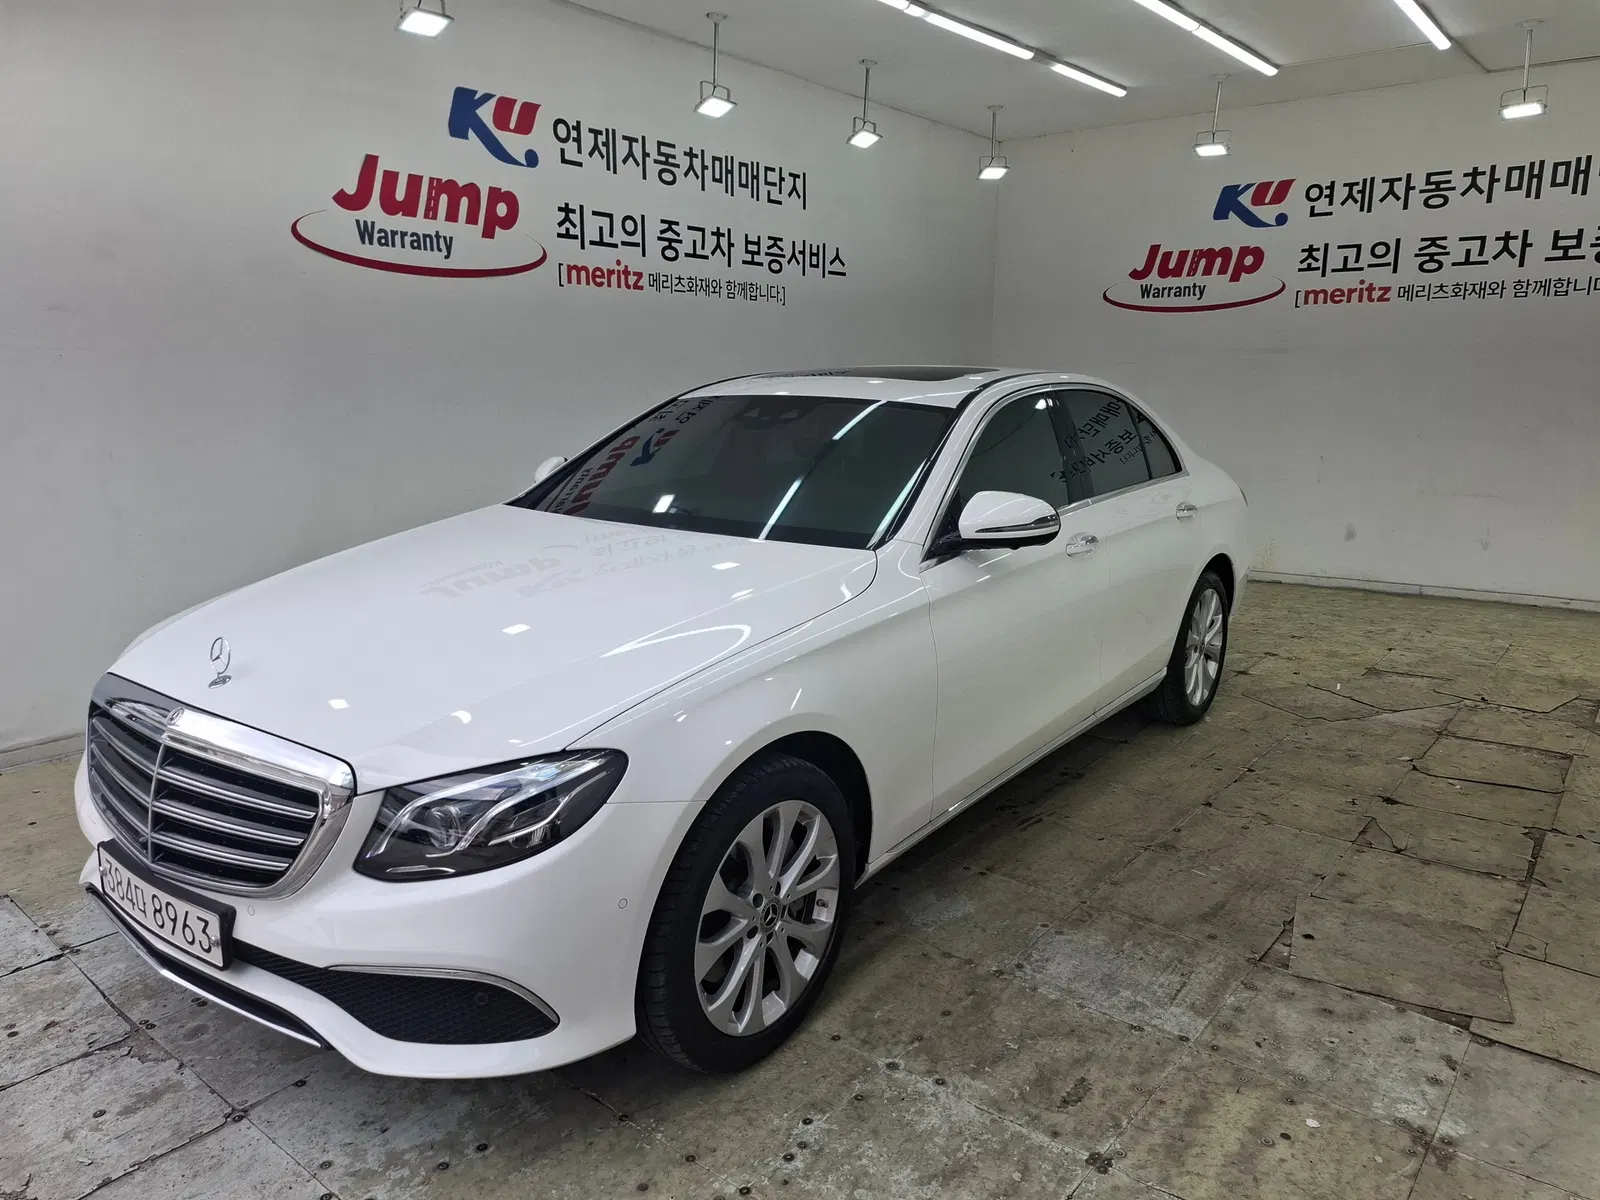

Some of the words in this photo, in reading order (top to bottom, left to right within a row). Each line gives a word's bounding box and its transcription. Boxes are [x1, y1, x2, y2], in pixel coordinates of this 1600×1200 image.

[552, 117, 808, 210] 연제자동차매매단지
[1304, 155, 1600, 218] 연제자동차매매
[332, 154, 520, 239] Jump
[355, 218, 454, 259] Warranty
[556, 202, 647, 257] 최고의
[656, 218, 735, 268] 중고차
[741, 241, 847, 279] 보증서비스
[1298, 237, 1401, 278] 최고의
[1413, 229, 1534, 274] 중고차
[648, 272, 723, 298] 메리츠화재와
[1128, 244, 1265, 283] Jump
[1140, 283, 1206, 300] Warranty
[1397, 280, 1507, 302] 메리츠화재와
[151, 893, 212, 953] 8963
